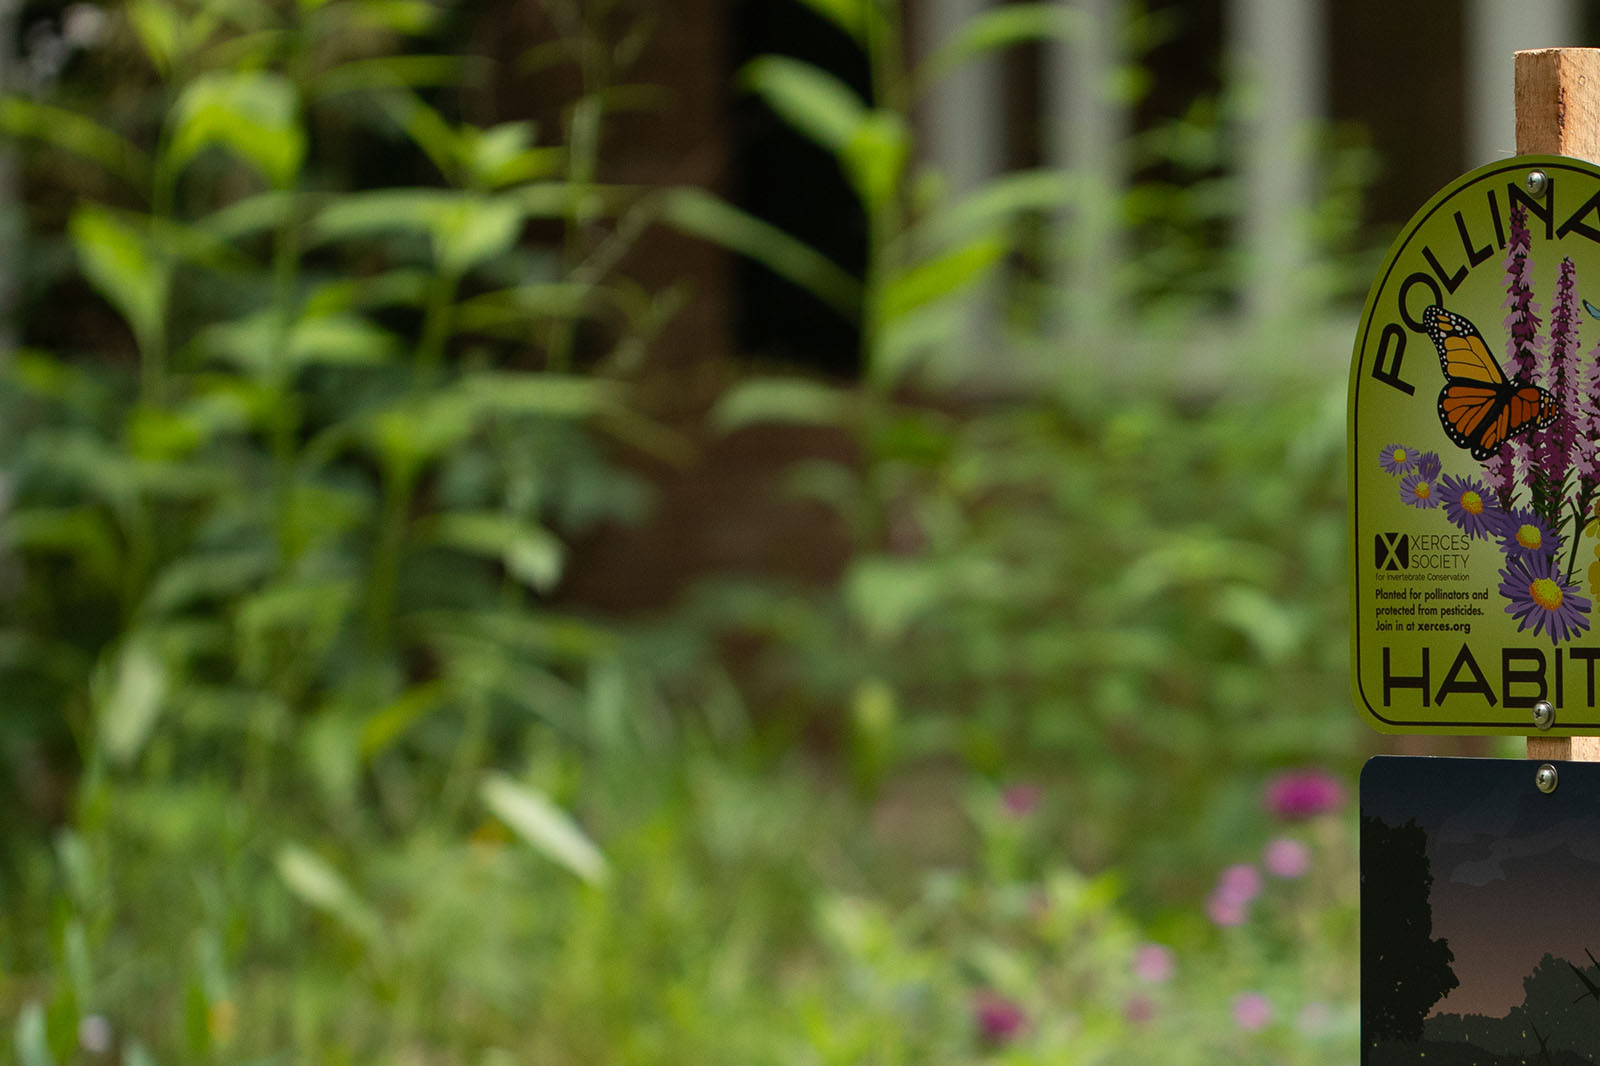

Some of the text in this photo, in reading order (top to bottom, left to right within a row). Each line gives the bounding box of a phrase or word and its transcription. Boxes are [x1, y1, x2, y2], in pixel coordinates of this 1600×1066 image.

[1411, 534, 1470, 551] XERCES
[1411, 554, 1470, 569] SOCIETY
[1375, 573, 1386, 581] for
[1427, 573, 1470, 581] Conservation
[1375, 588, 1489, 602] Planted for pollinators and
[1375, 604, 1484, 618] protected from pesticides.
[1375, 621, 1471, 634] Join in at xerces.org
